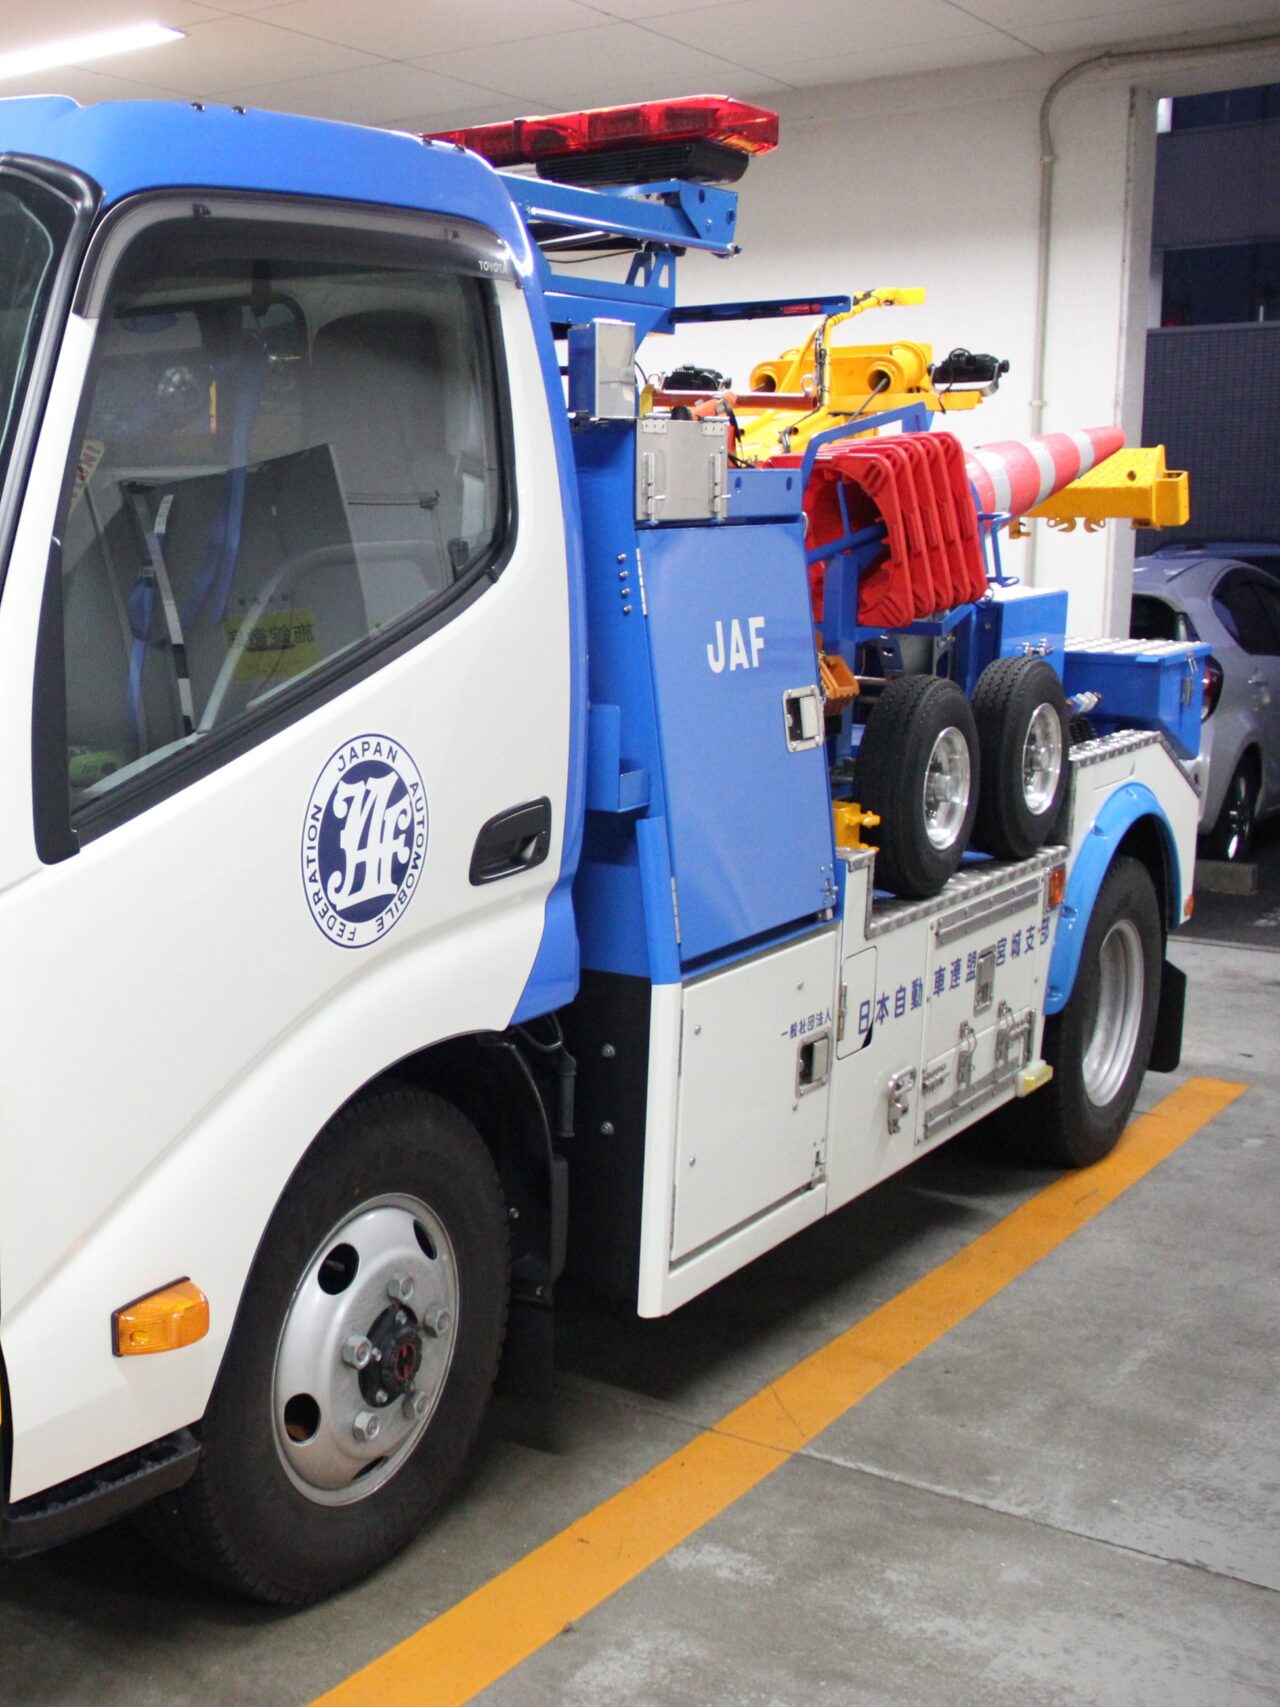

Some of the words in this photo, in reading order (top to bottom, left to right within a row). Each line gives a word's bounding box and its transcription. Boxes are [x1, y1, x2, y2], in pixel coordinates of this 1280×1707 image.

[706, 615, 766, 674] JAF
[337, 741, 398, 772] JAPAN
[306, 804, 357, 942] FEDERATION
[375, 781, 426, 933] AUTOMOBILE
[780, 1007, 832, 1039] 一般社団法人
